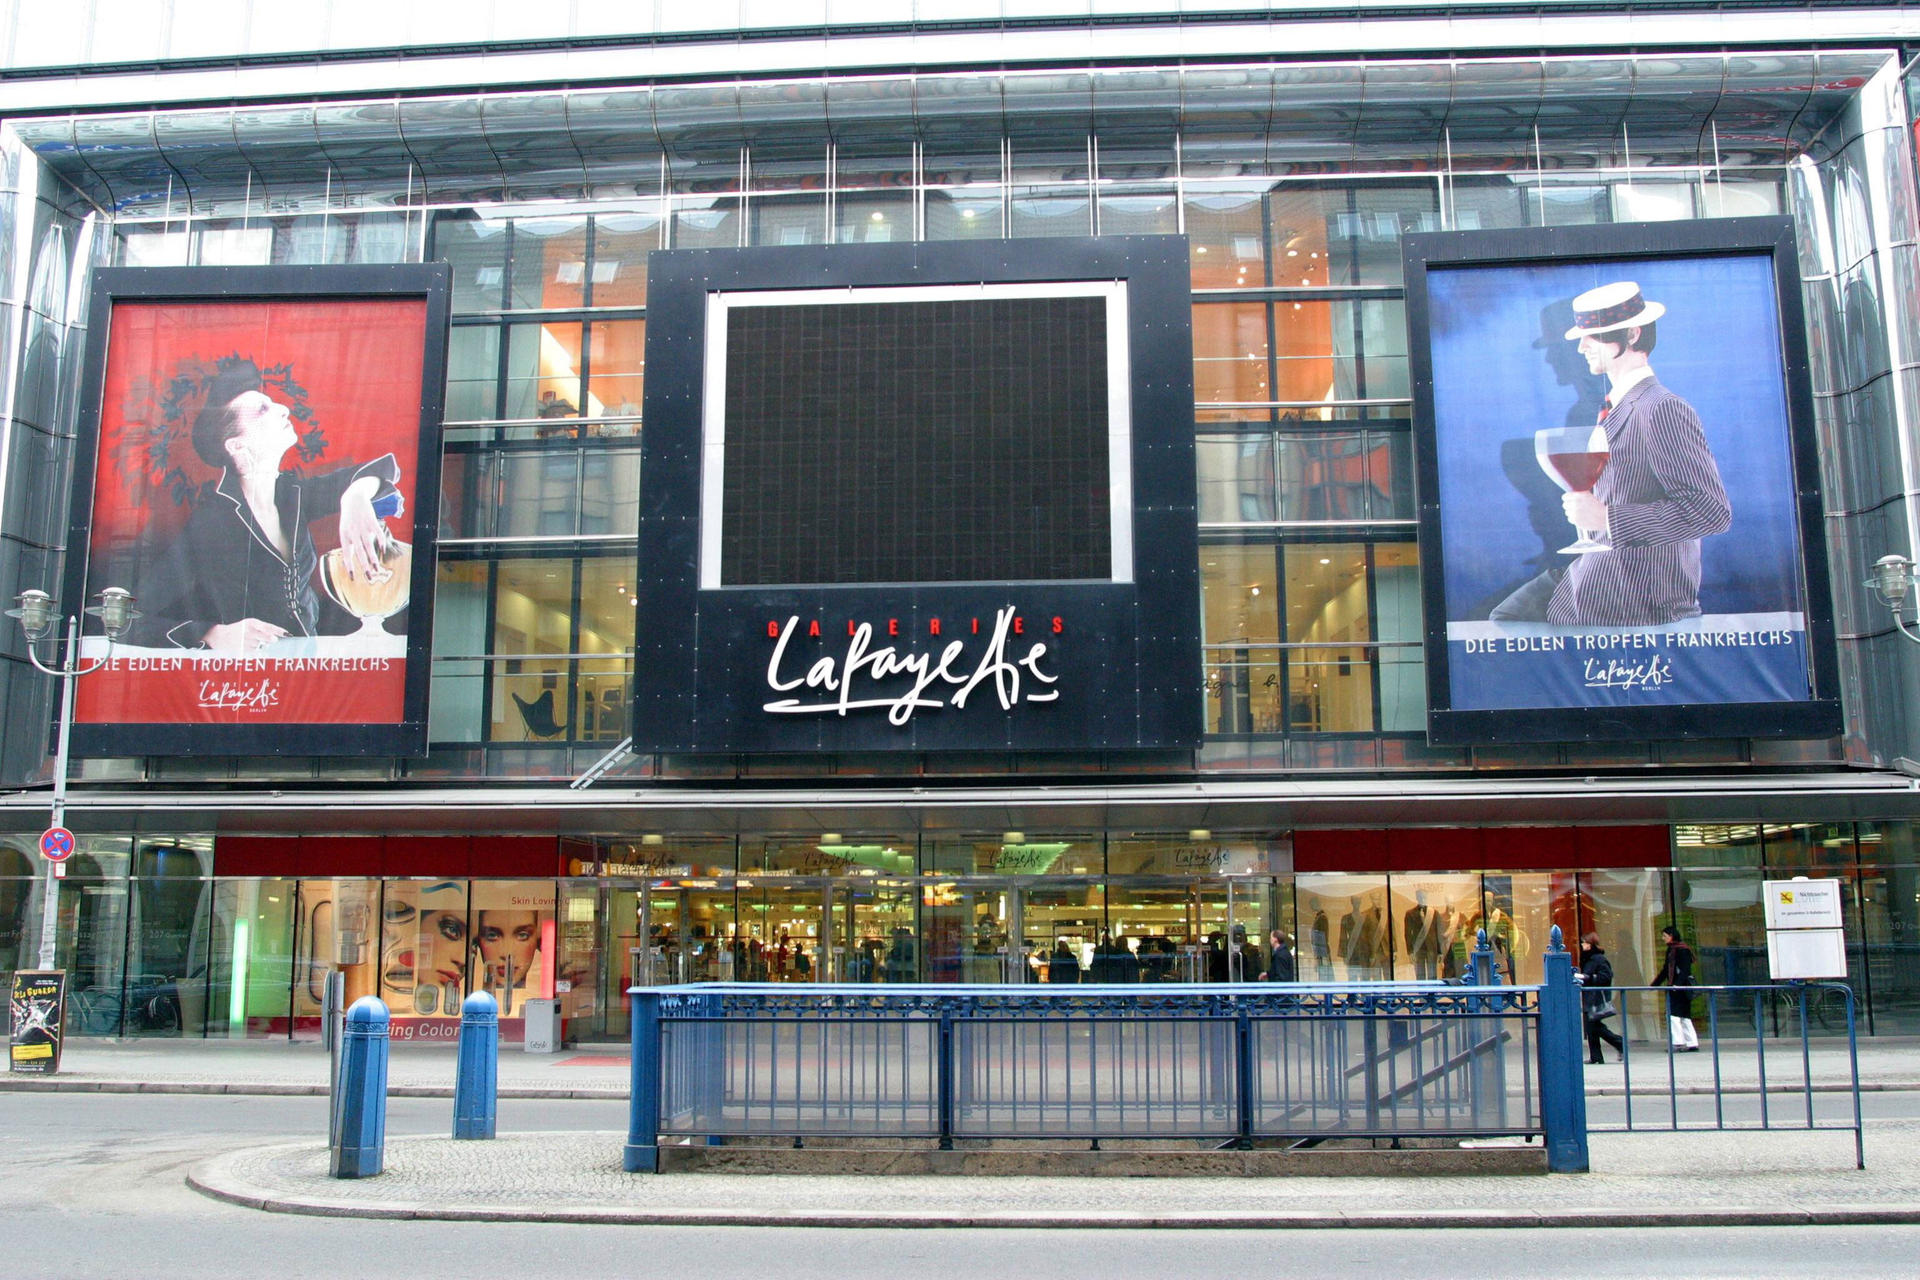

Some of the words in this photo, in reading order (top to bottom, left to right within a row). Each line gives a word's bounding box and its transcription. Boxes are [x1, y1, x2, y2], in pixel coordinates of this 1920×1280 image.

[767, 616, 1064, 638] GALERIES
[1465, 637, 1496, 653] DIE
[1506, 636, 1565, 652] EDLEN
[1573, 633, 1657, 650] TROPFEN
[1666, 629, 1793, 648] FRANKREICHS
[92, 656, 120, 671] DIE
[128, 657, 182, 671] EDLEN
[192, 657, 266, 671] TROPFEN
[274, 656, 390, 671] FRANKREICHS
[763, 605, 1059, 726] Lafayette
[1584, 654, 1673, 690] Lafayette
[197, 678, 279, 712] Lafayette
[511, 896, 530, 905] Skin
